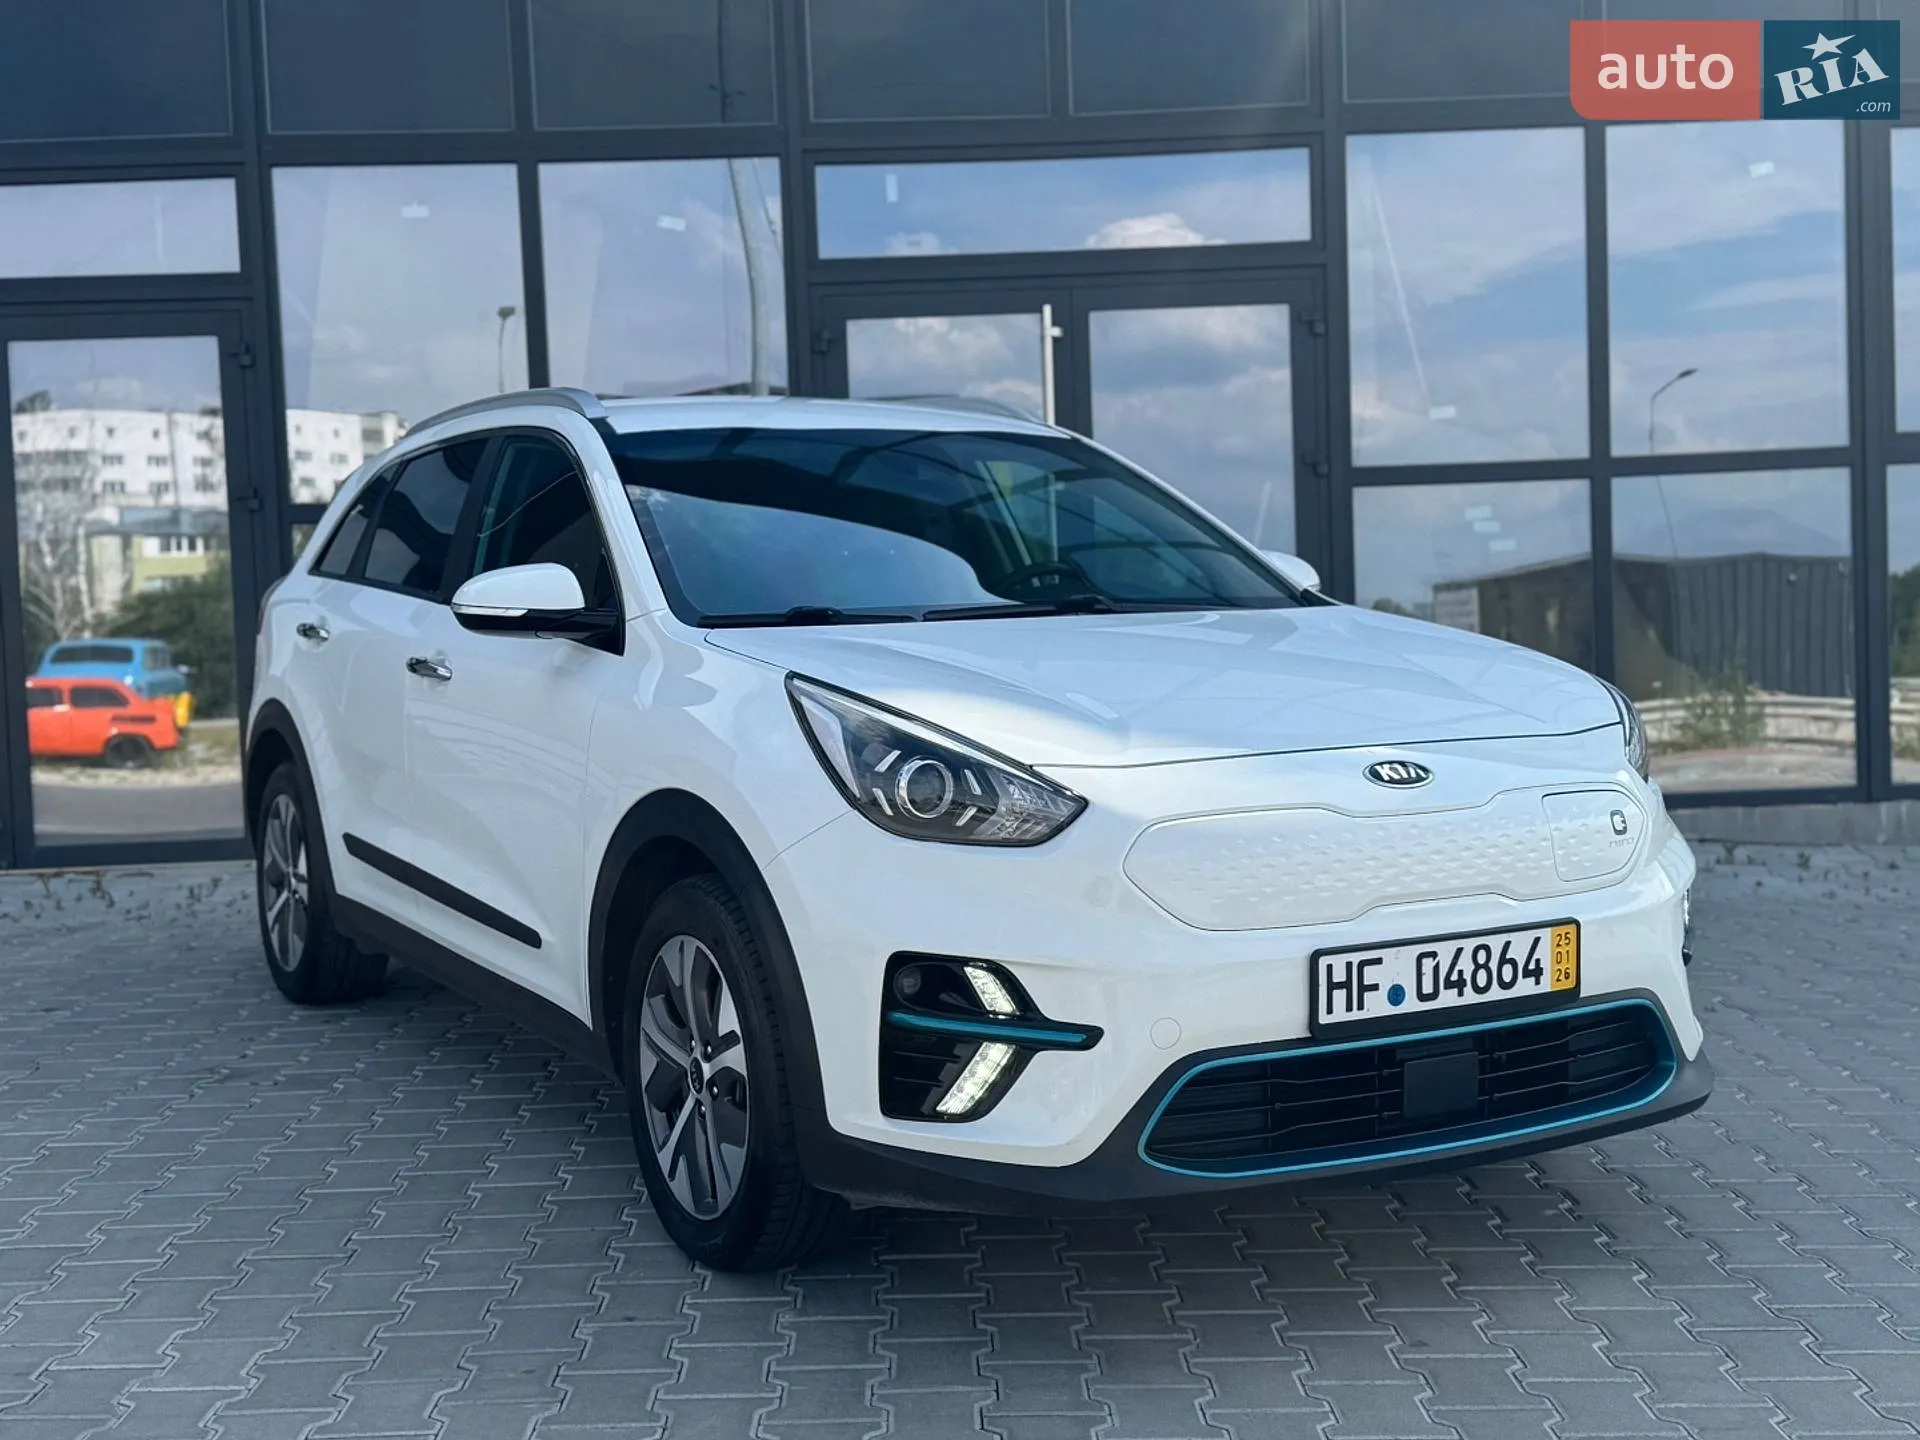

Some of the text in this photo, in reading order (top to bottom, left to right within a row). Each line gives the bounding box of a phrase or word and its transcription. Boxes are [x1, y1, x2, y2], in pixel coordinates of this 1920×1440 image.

[1373, 763, 1428, 781] KIA
[1555, 931, 1572, 948] 25
[1555, 949, 1571, 965] 01
[1325, 935, 1545, 1016] HF 04864
[1555, 967, 1572, 983] 26
